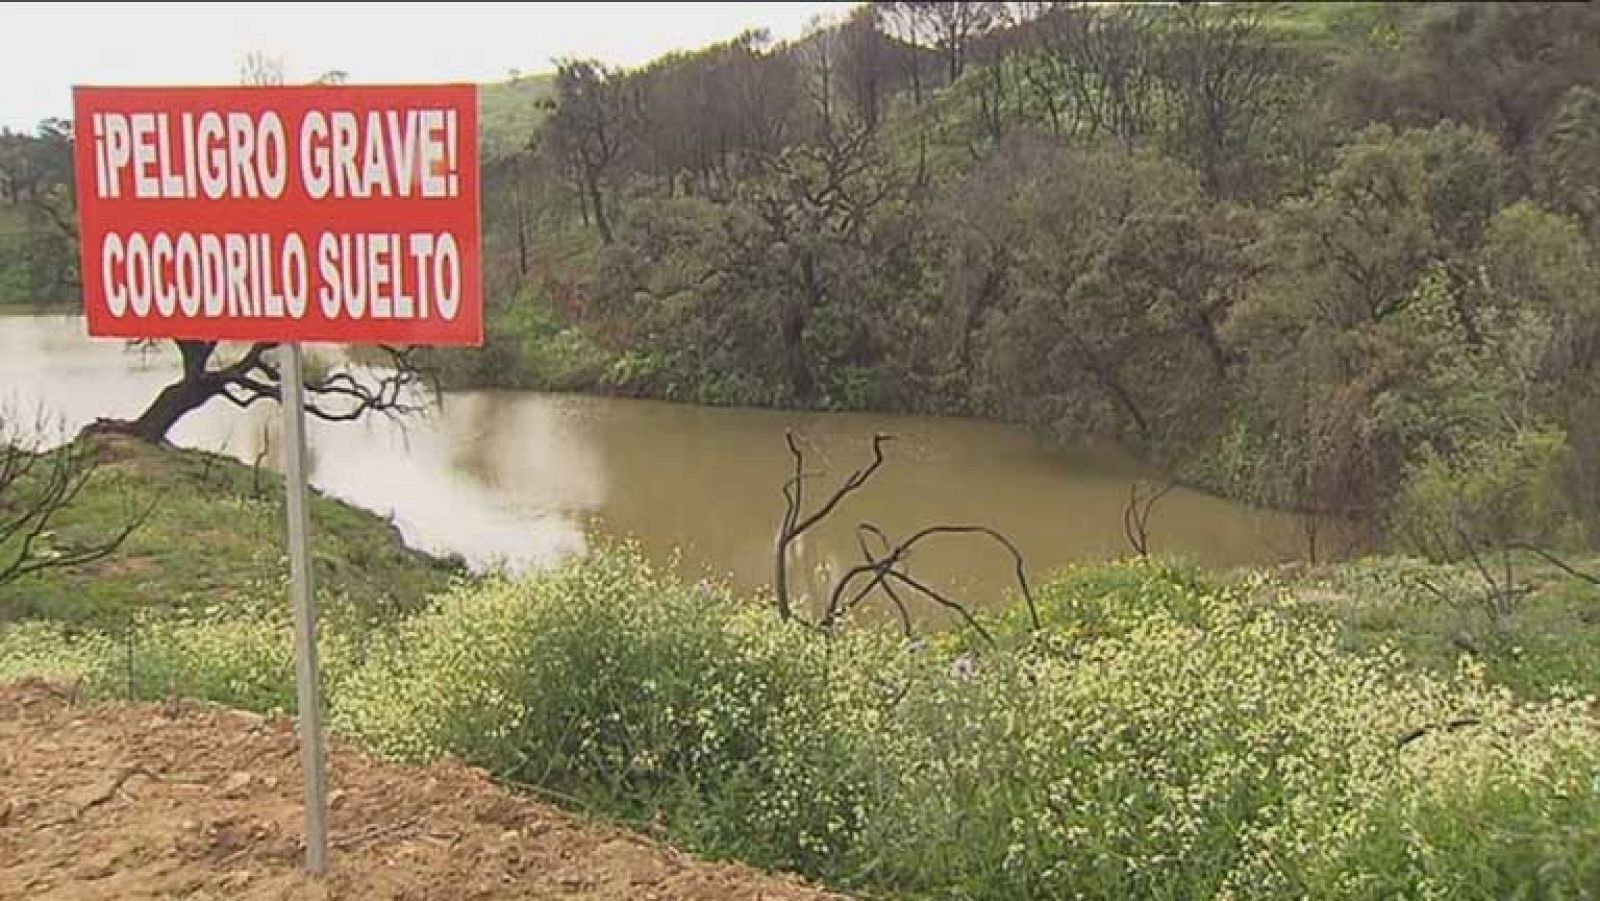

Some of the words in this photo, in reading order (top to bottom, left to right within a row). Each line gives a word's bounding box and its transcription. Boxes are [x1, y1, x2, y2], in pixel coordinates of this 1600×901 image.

[93, 110, 287, 199] ¡PELIGRO
[300, 109, 459, 198] GRAVE!
[103, 231, 308, 319] COCODRILO
[318, 231, 461, 320] SUELTO
